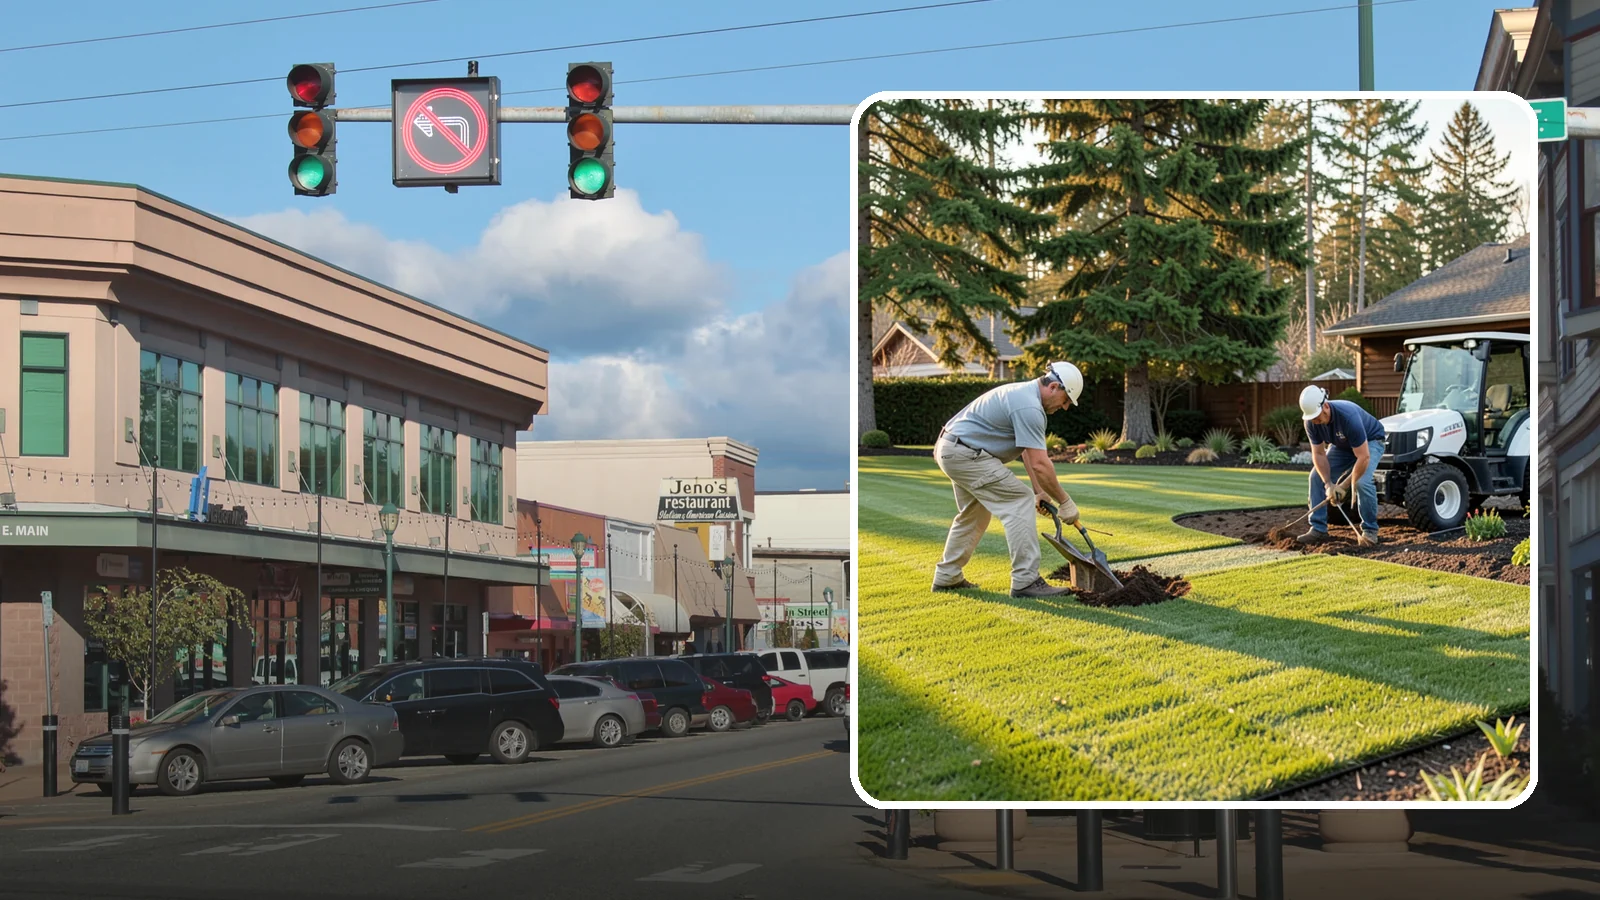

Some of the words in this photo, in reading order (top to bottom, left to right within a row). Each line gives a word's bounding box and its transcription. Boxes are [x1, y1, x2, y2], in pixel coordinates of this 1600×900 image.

[670, 480, 728, 494] Jeno's
[665, 496, 731, 509] restaurant
[659, 510, 681, 519] Italian
[686, 509, 715, 519] American
[715, 509, 738, 519] Cuisine
[2, 525, 13, 536] E.
[15, 525, 49, 536] MAIN
[797, 607, 829, 616] Street
